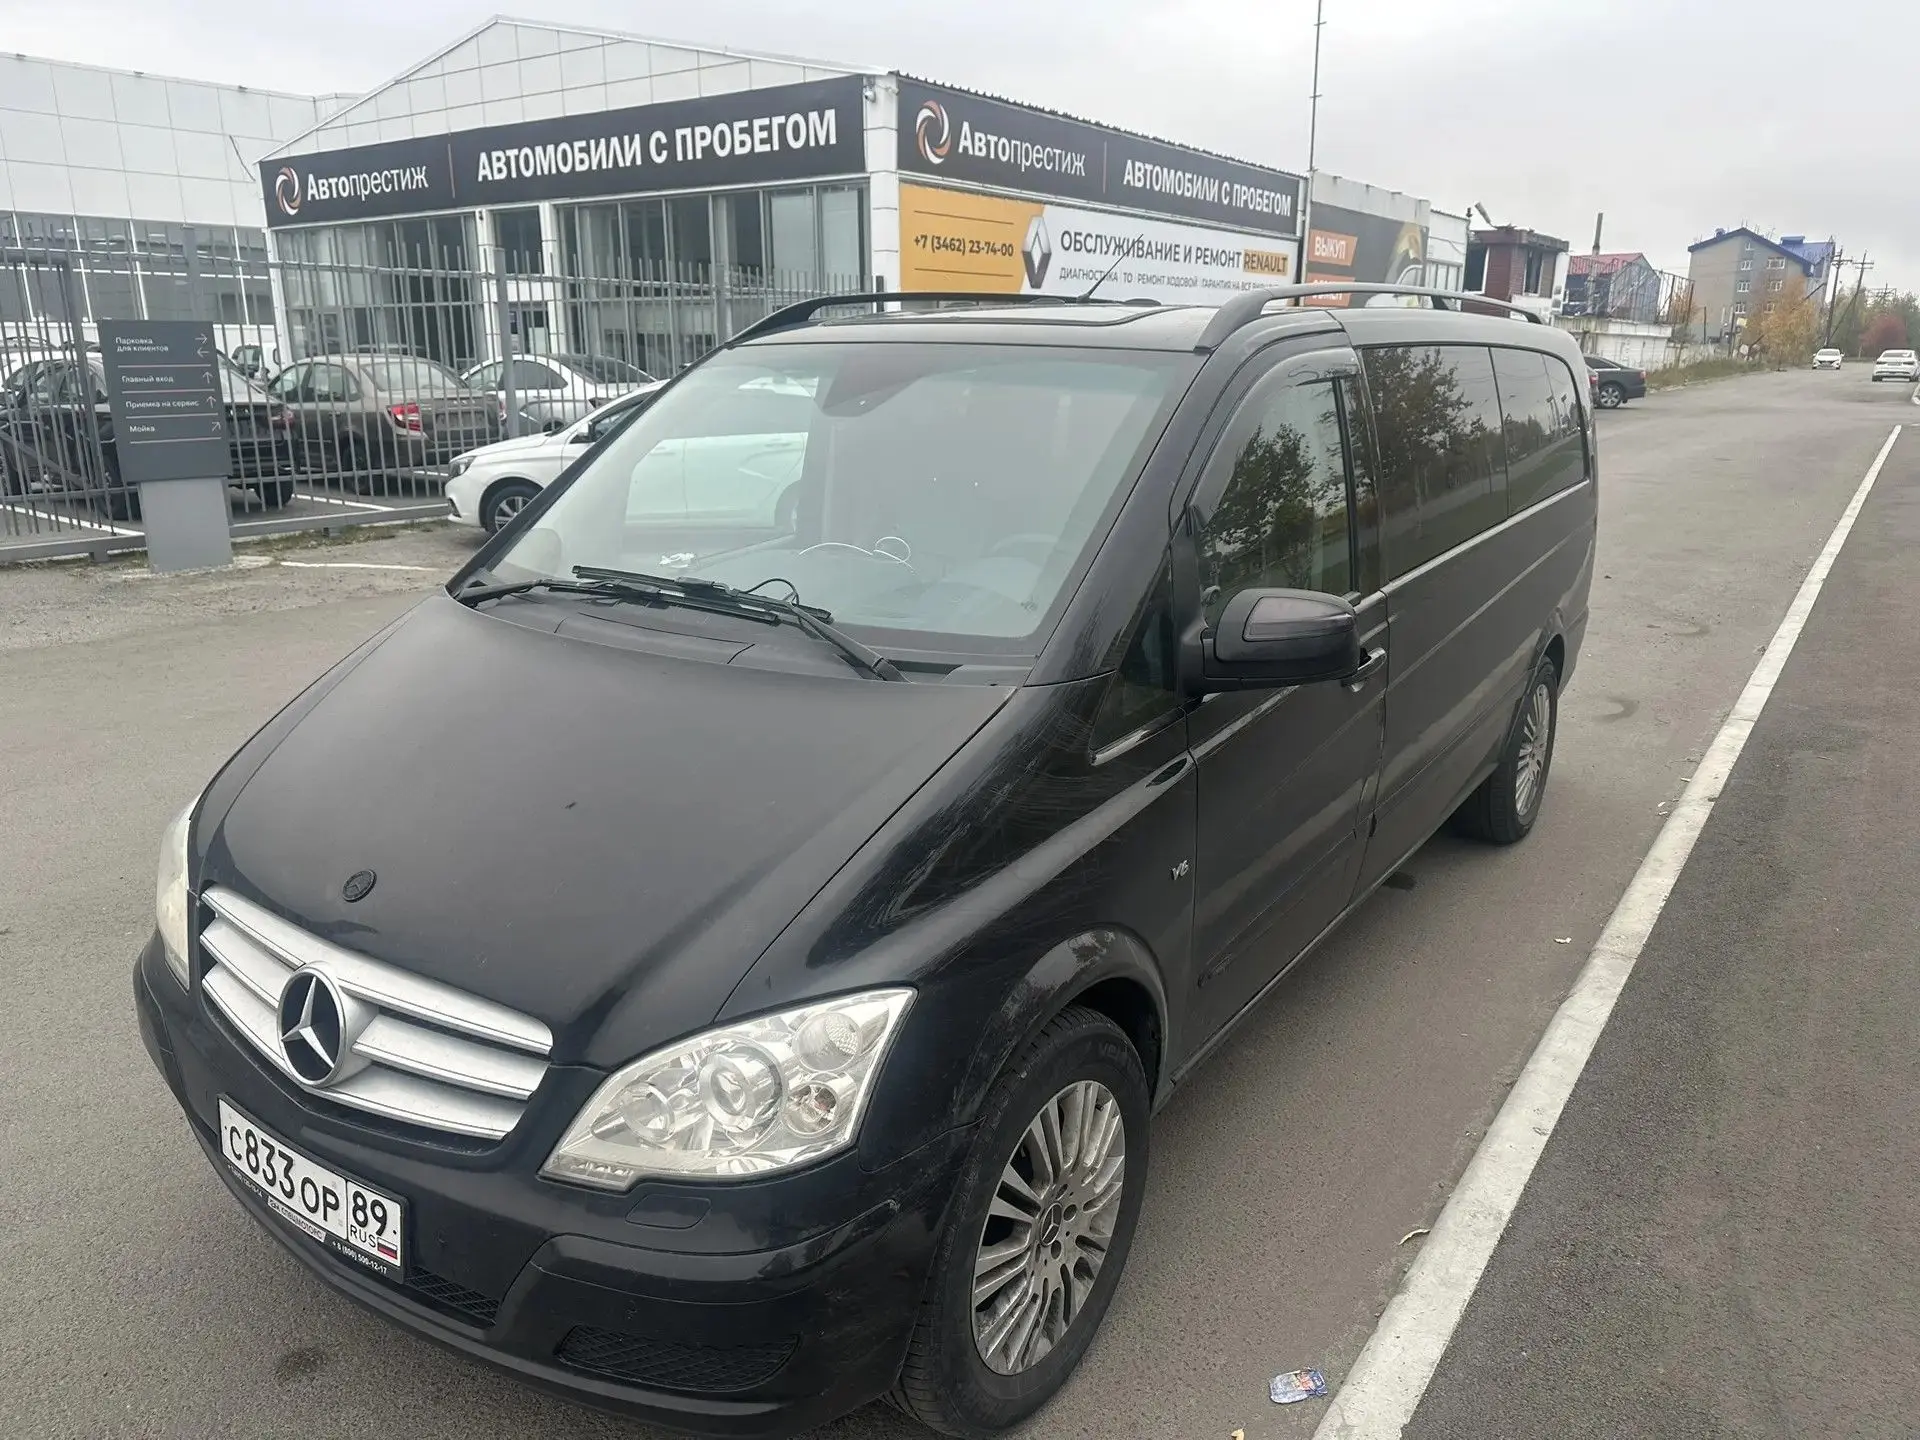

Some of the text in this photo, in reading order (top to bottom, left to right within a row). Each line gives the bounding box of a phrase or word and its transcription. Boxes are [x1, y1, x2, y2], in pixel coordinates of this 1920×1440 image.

[477, 109, 838, 183] АВТОМОБИЛИ С ПРОБЕГОМ
[958, 121, 1086, 177] Автопрестиж
[306, 162, 429, 203] Автопрестиж
[1123, 159, 1292, 217] АВТОМОБИЛИ С ПРОБЕГОМ
[914, 234, 1014, 257] +7 (3462) 23-74-00
[1060, 230, 1288, 273] ОБСЛУЖИВАНИЕ И РЕМОНТ RENAULT
[1314, 235, 1347, 260] ВЫКУП
[115, 336, 154, 345] Парковка
[121, 375, 174, 383] Главный вход
[172, 400, 200, 408] сервис
[129, 424, 156, 433] Мойка
[352, 1190, 388, 1237] 89
[350, 1224, 377, 1248] RUS
